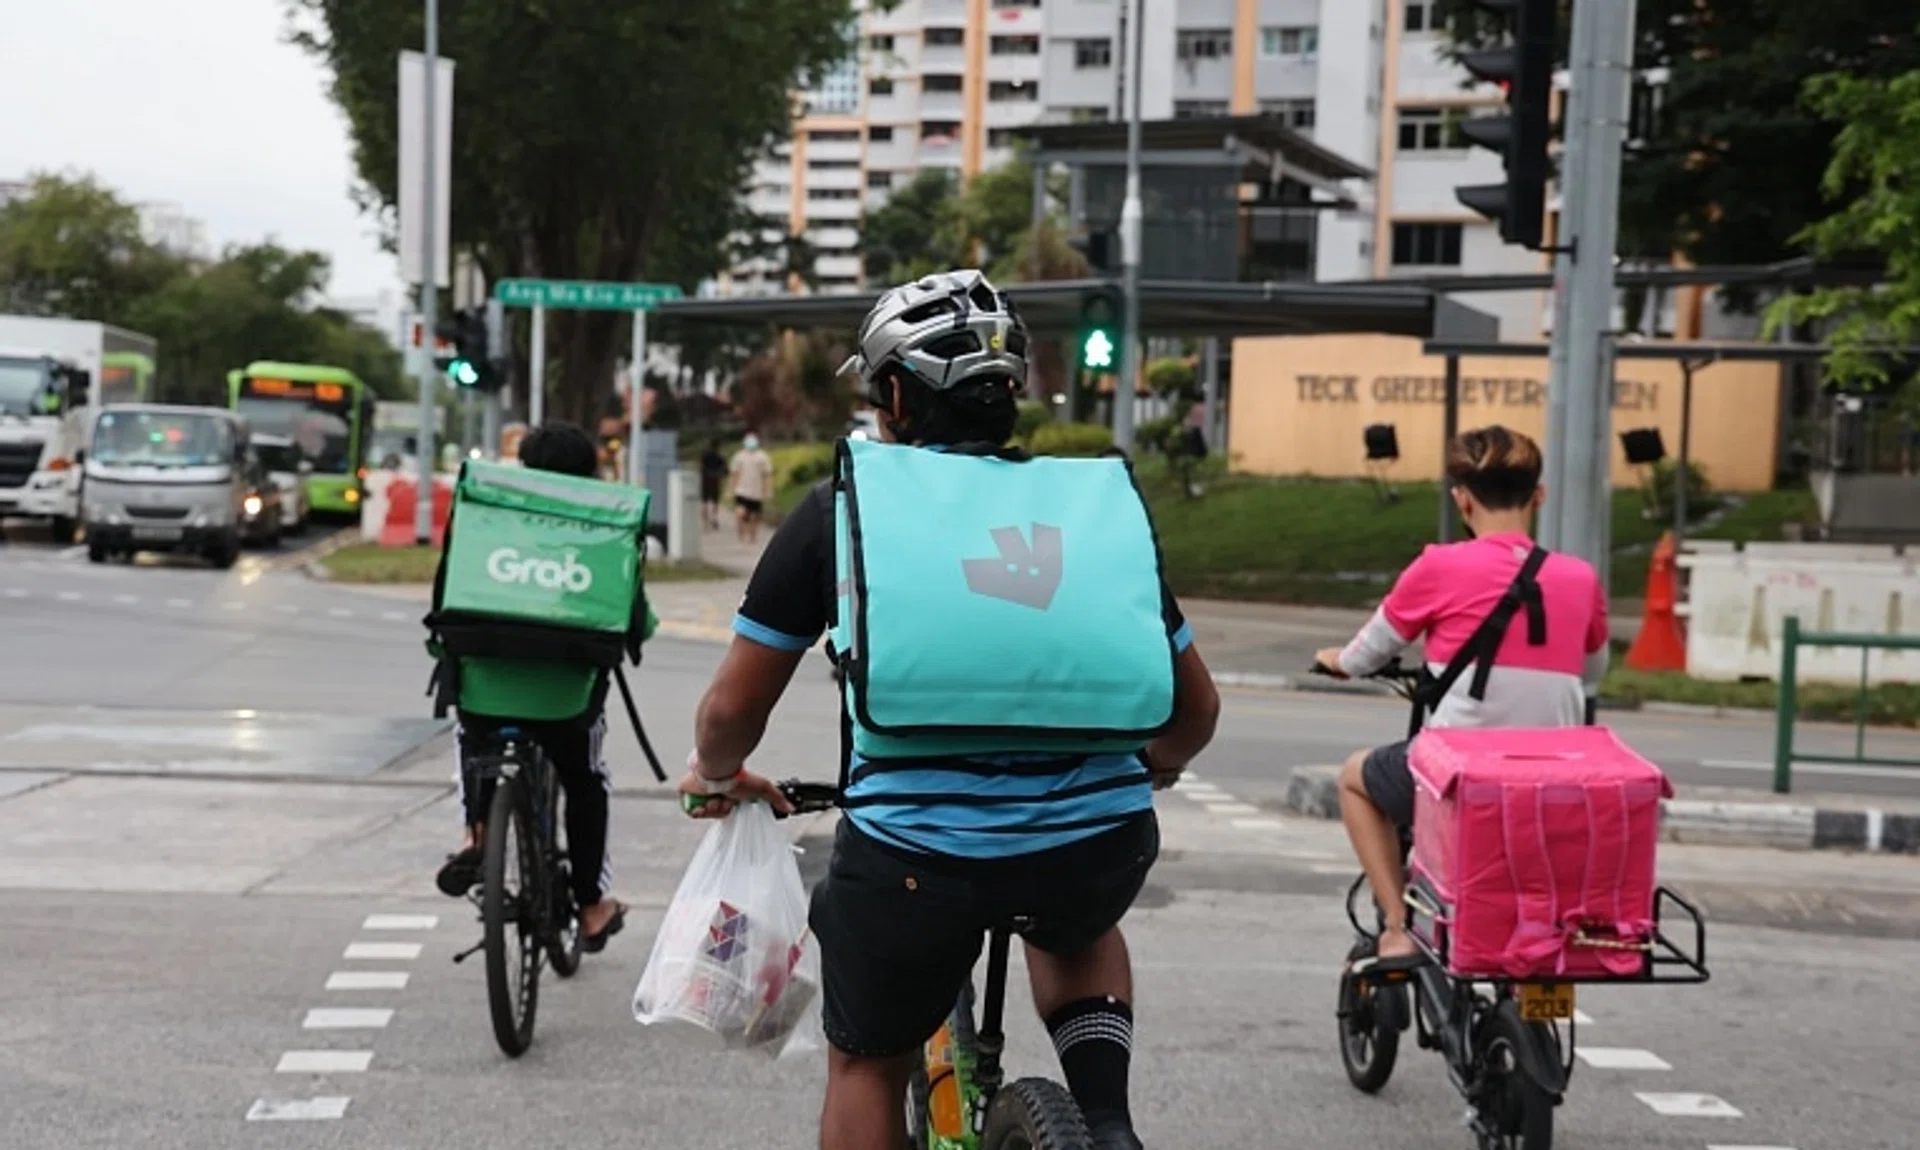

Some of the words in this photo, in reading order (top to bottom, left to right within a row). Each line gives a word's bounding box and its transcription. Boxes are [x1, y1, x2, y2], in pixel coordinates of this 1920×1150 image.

[507, 281, 545, 302] Ang
[549, 284, 578, 300] Mo
[1295, 374, 1359, 402] TECK
[1460, 376, 1660, 411] EVEREN
[487, 546, 593, 592] Grab
